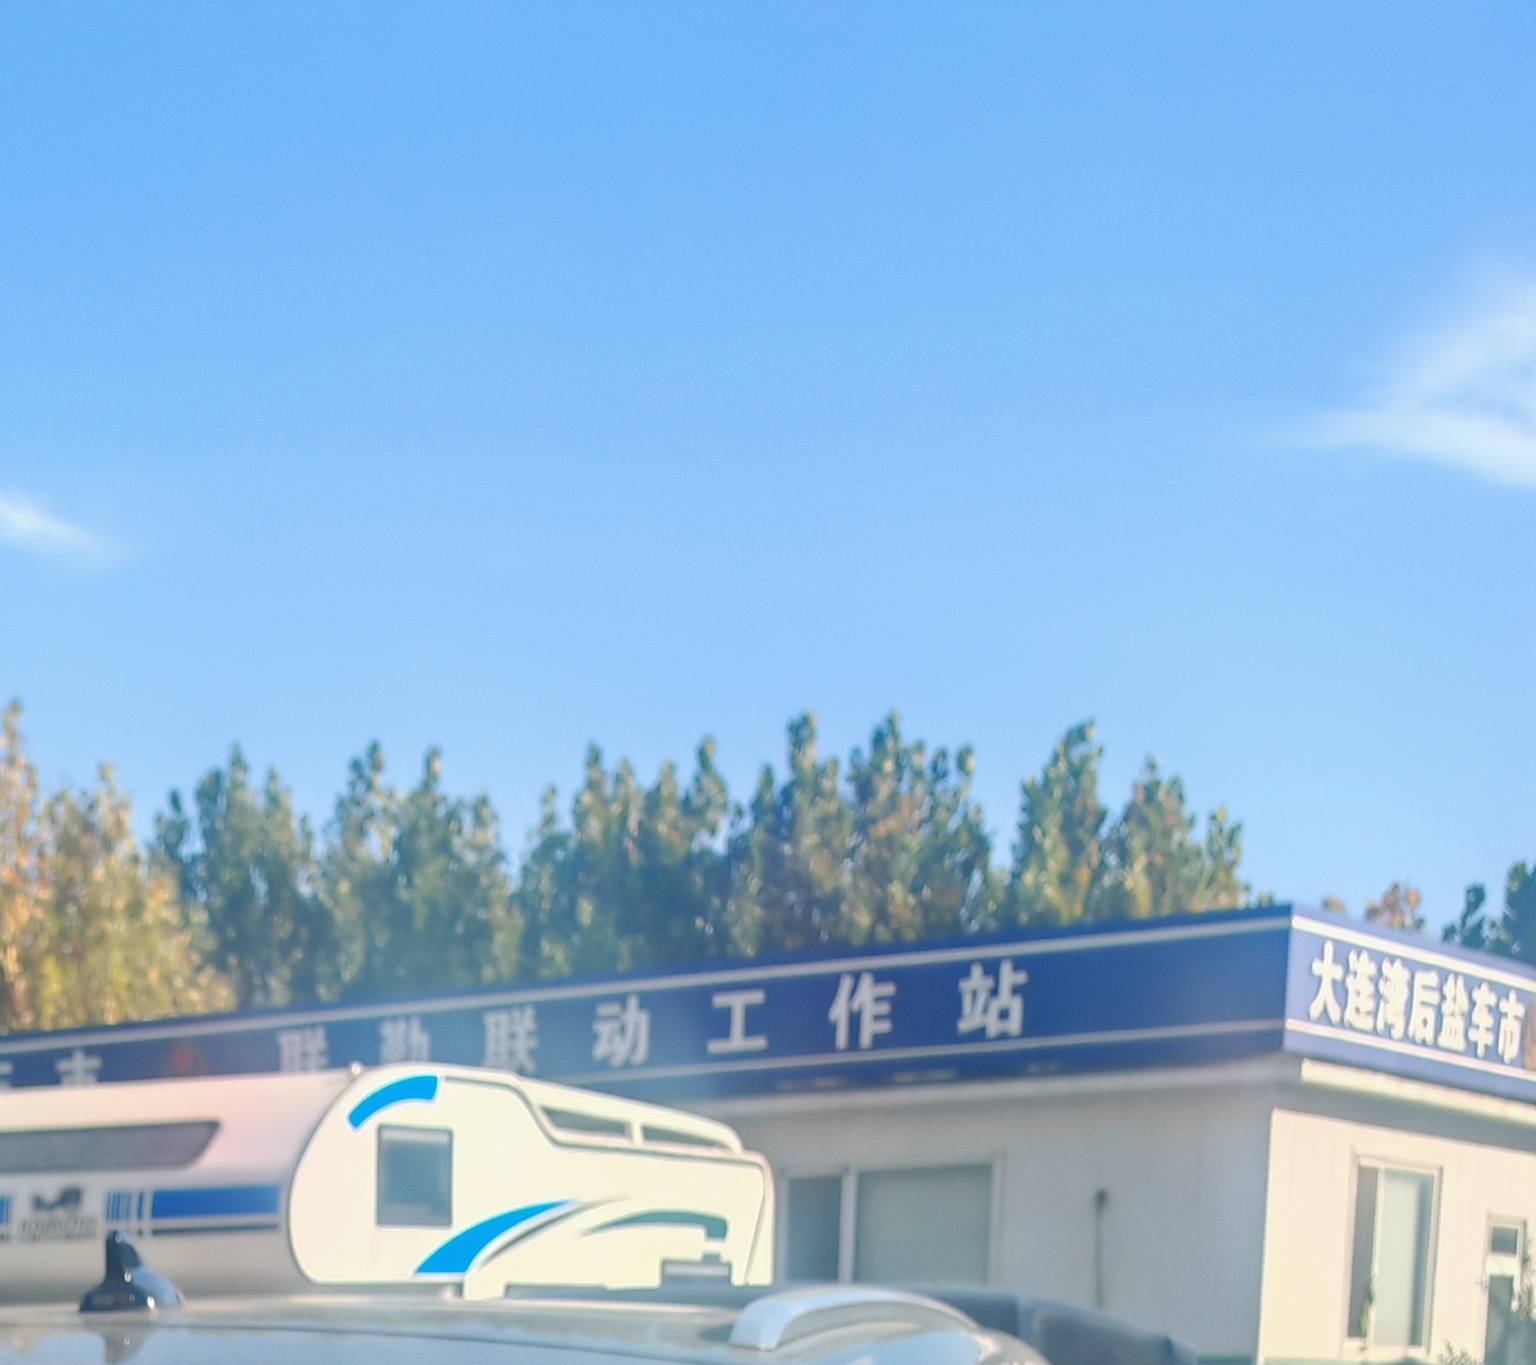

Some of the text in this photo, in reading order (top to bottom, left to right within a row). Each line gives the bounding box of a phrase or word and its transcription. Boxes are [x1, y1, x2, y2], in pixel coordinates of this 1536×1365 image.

[278, 959, 1028, 1074] 联勤联动工作站
[1308, 939, 1525, 1064] 大连湾后盐车市
